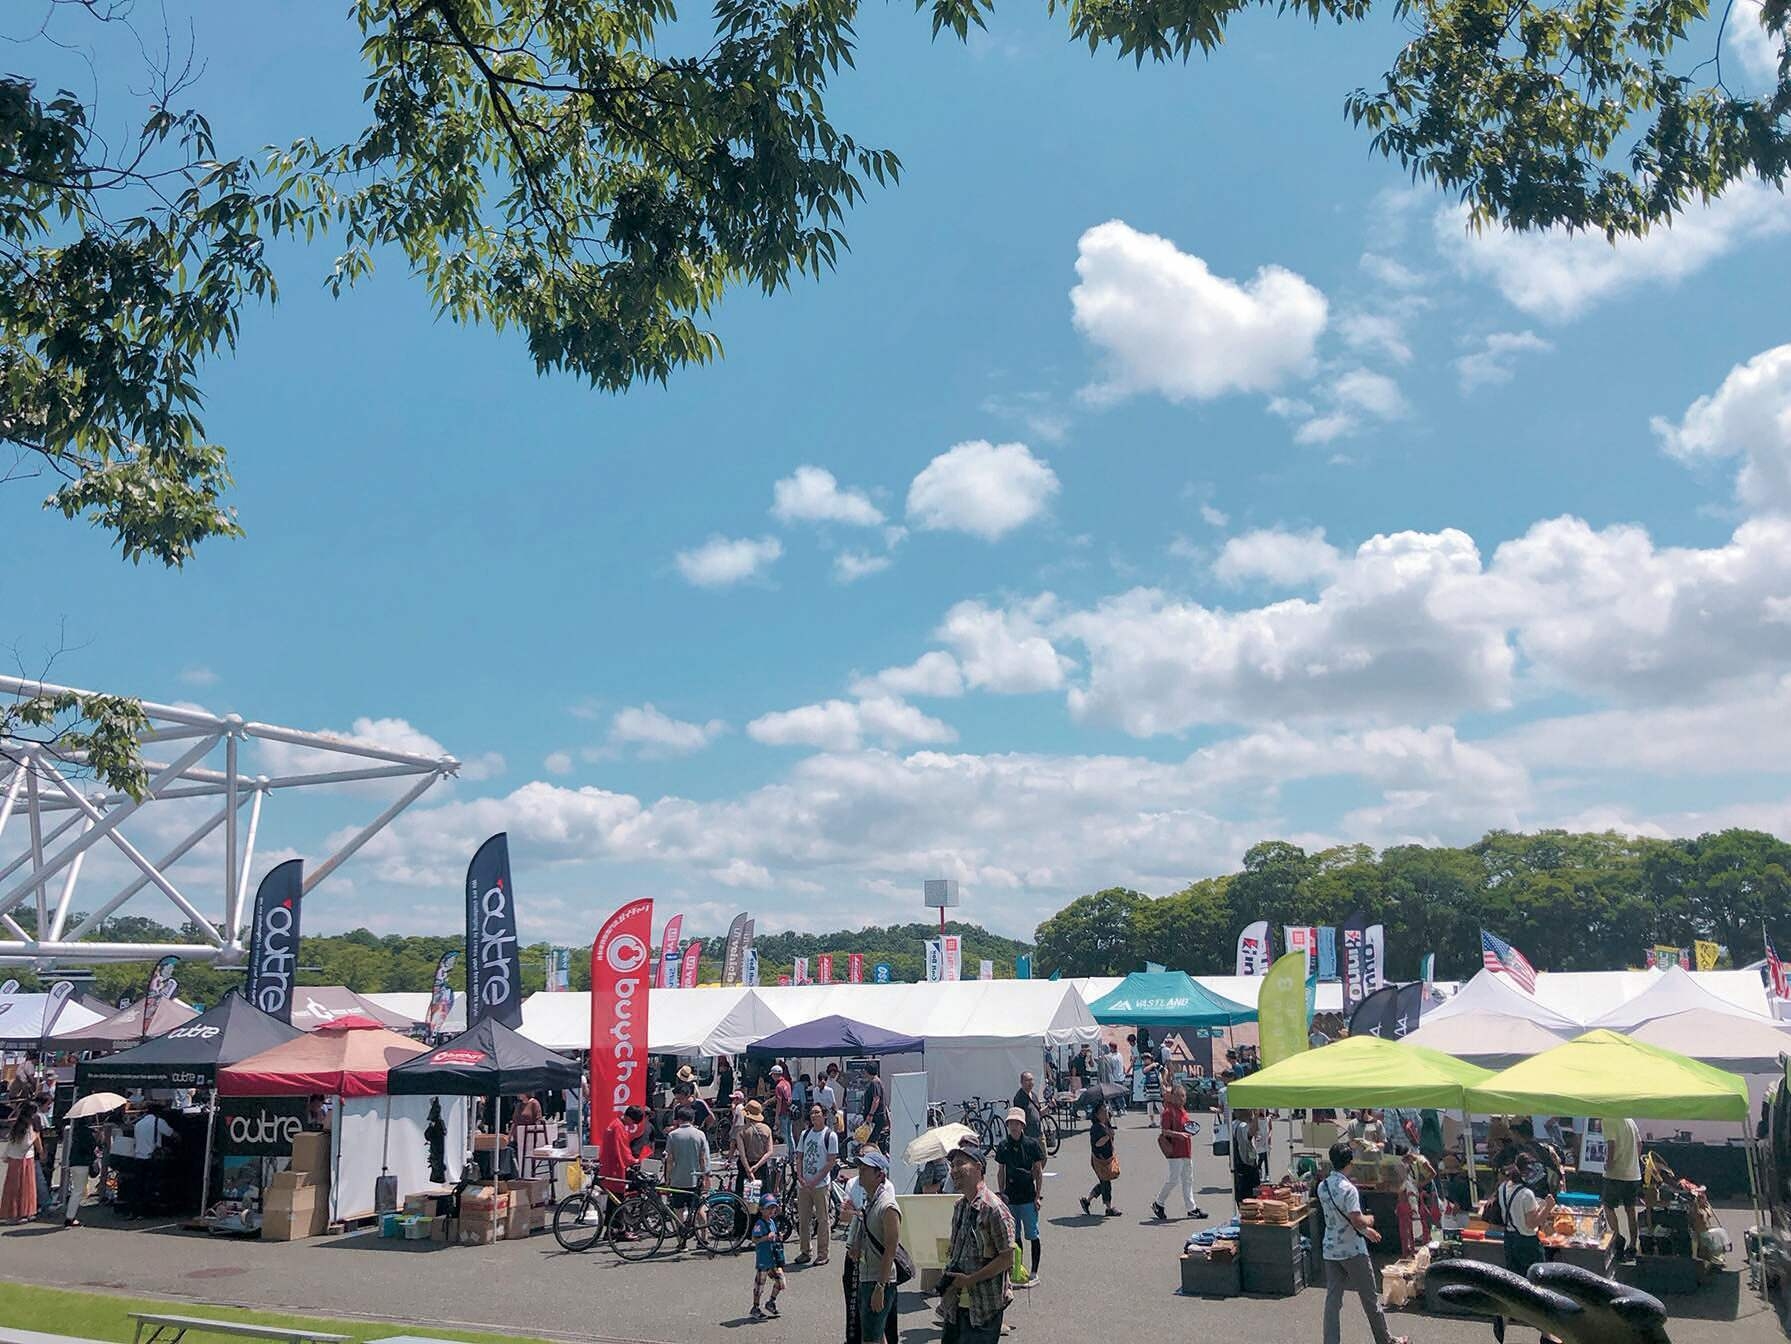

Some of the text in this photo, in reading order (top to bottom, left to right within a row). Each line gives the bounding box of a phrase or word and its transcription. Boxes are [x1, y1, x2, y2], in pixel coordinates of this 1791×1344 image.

[258, 906, 295, 1012] outre
[482, 888, 516, 1005] outre
[167, 1023, 221, 1039] outre
[610, 978, 640, 1117] buychar
[172, 1072, 196, 1082] outre
[230, 1109, 303, 1144] outre
